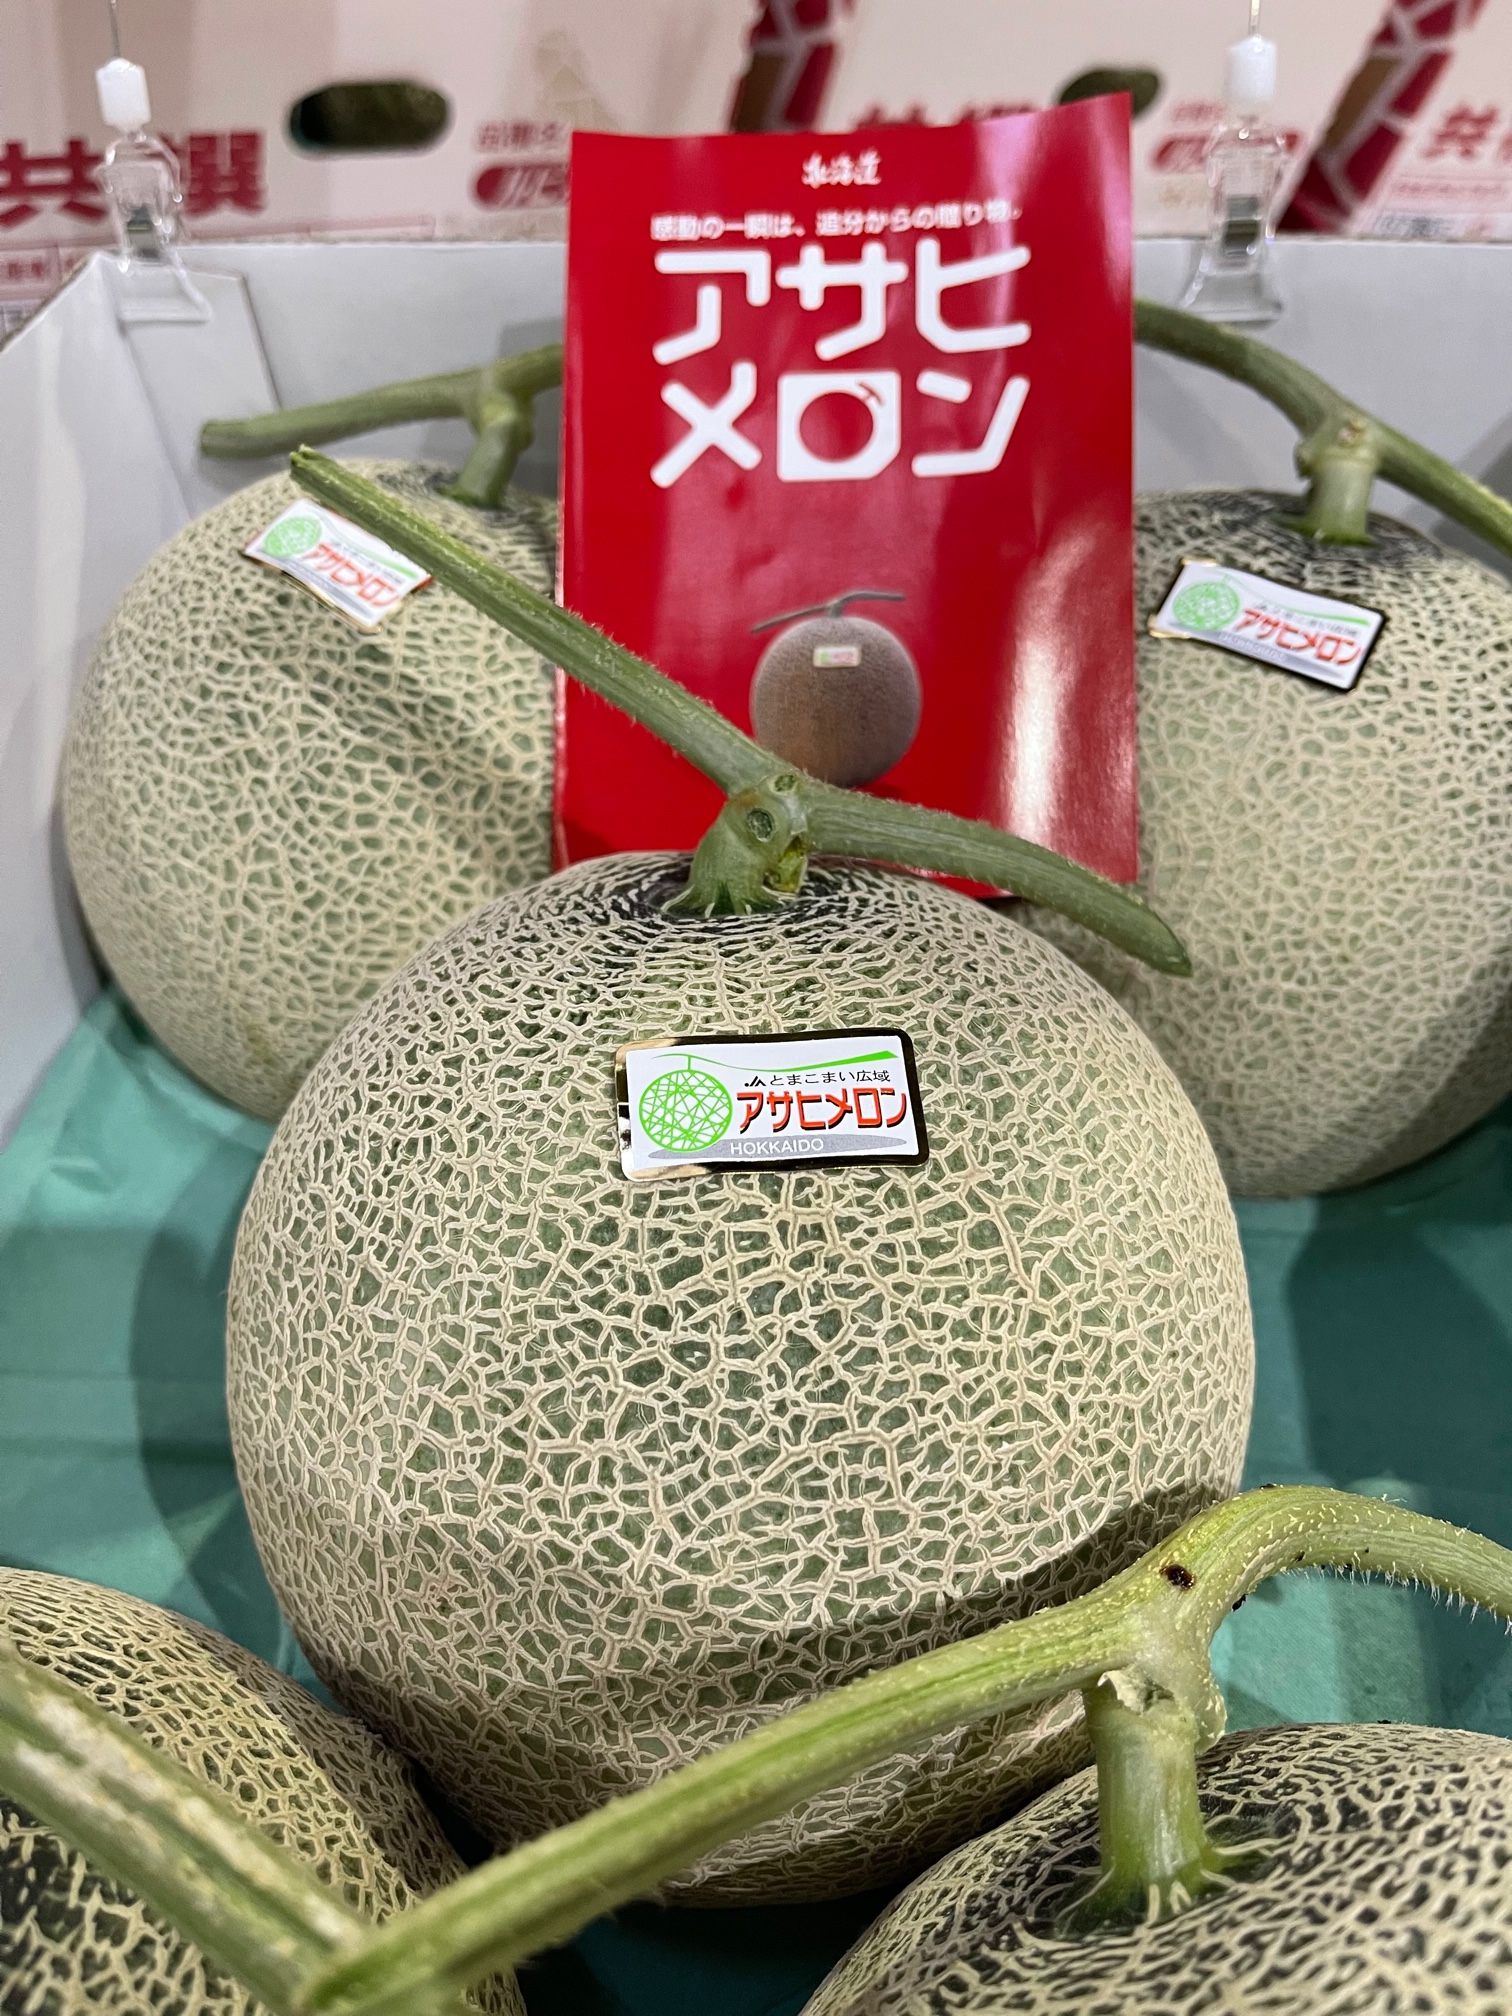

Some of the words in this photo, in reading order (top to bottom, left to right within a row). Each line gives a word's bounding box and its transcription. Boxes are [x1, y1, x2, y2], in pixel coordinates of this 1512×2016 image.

[803, 149, 881, 188] 北海道
[653, 237, 1031, 365] アサヒ
[650, 360, 1030, 488] メロン
[1234, 608, 1363, 665] アサヒメロン
[736, 1087, 907, 1134] アサヒメロン
[730, 1138, 824, 1155] HOKKAIDO
